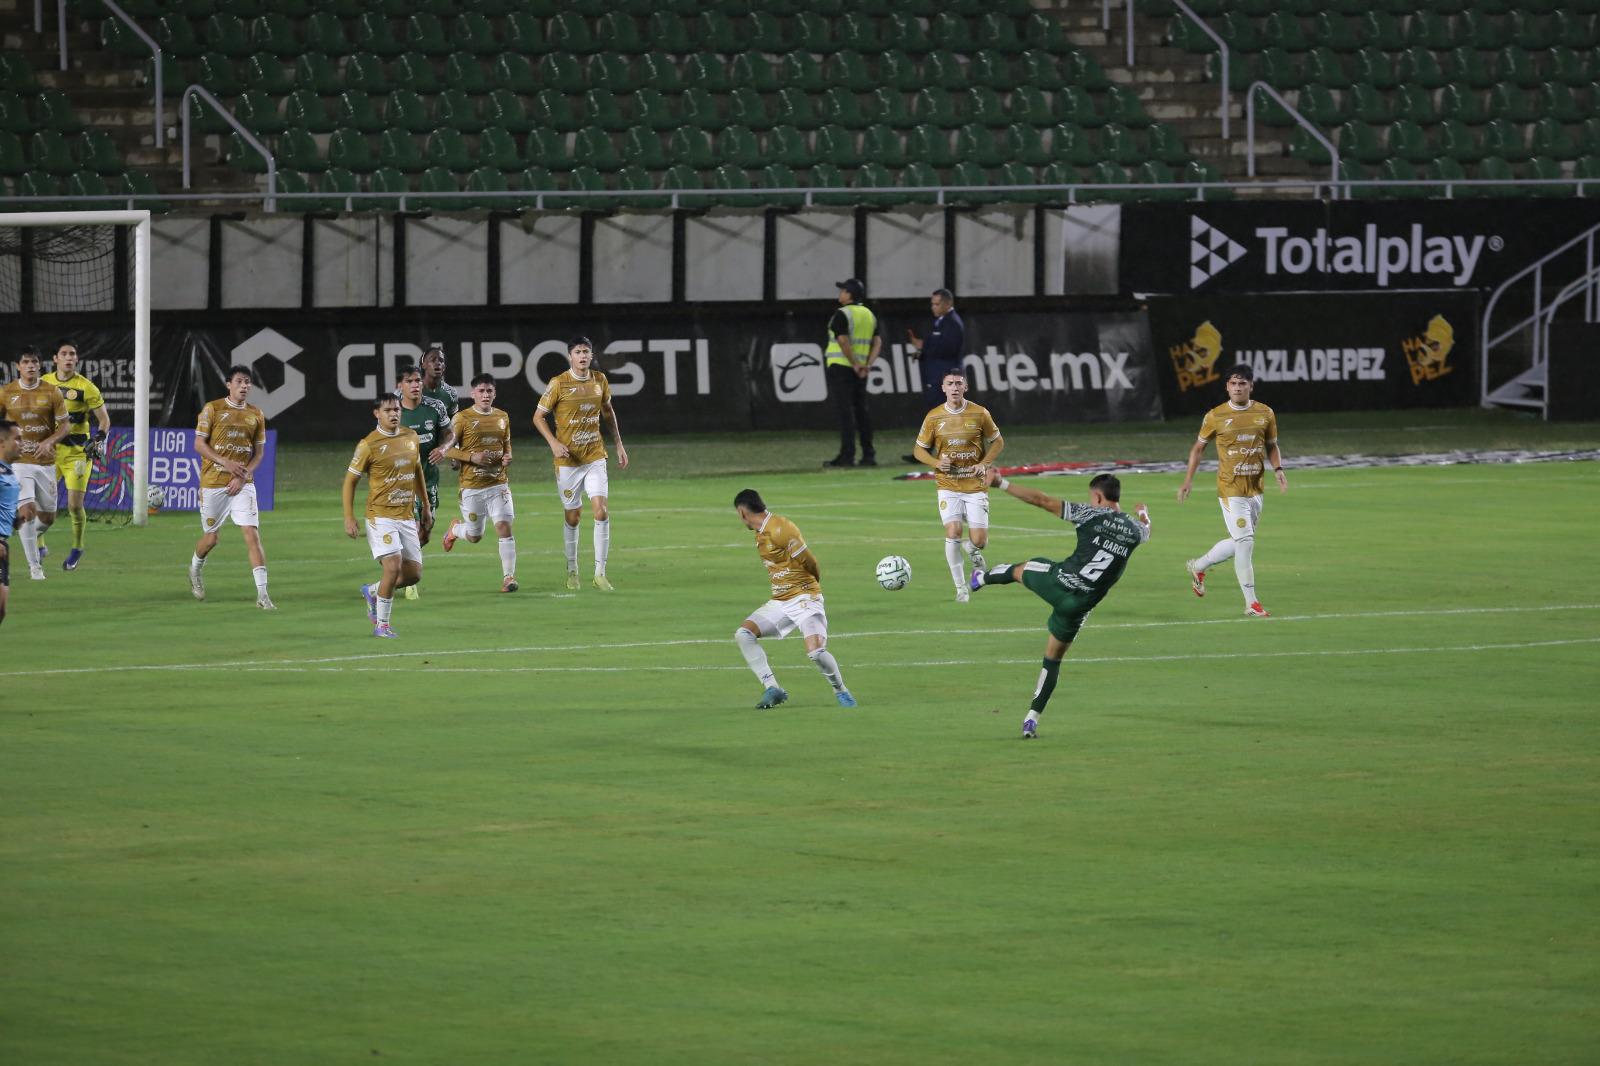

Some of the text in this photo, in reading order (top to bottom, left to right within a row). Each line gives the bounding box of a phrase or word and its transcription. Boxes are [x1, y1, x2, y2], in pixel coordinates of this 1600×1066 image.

[153, 430, 186, 453] LIGA
[151, 456, 202, 484] BBV
[1078, 548, 1115, 583] 2
